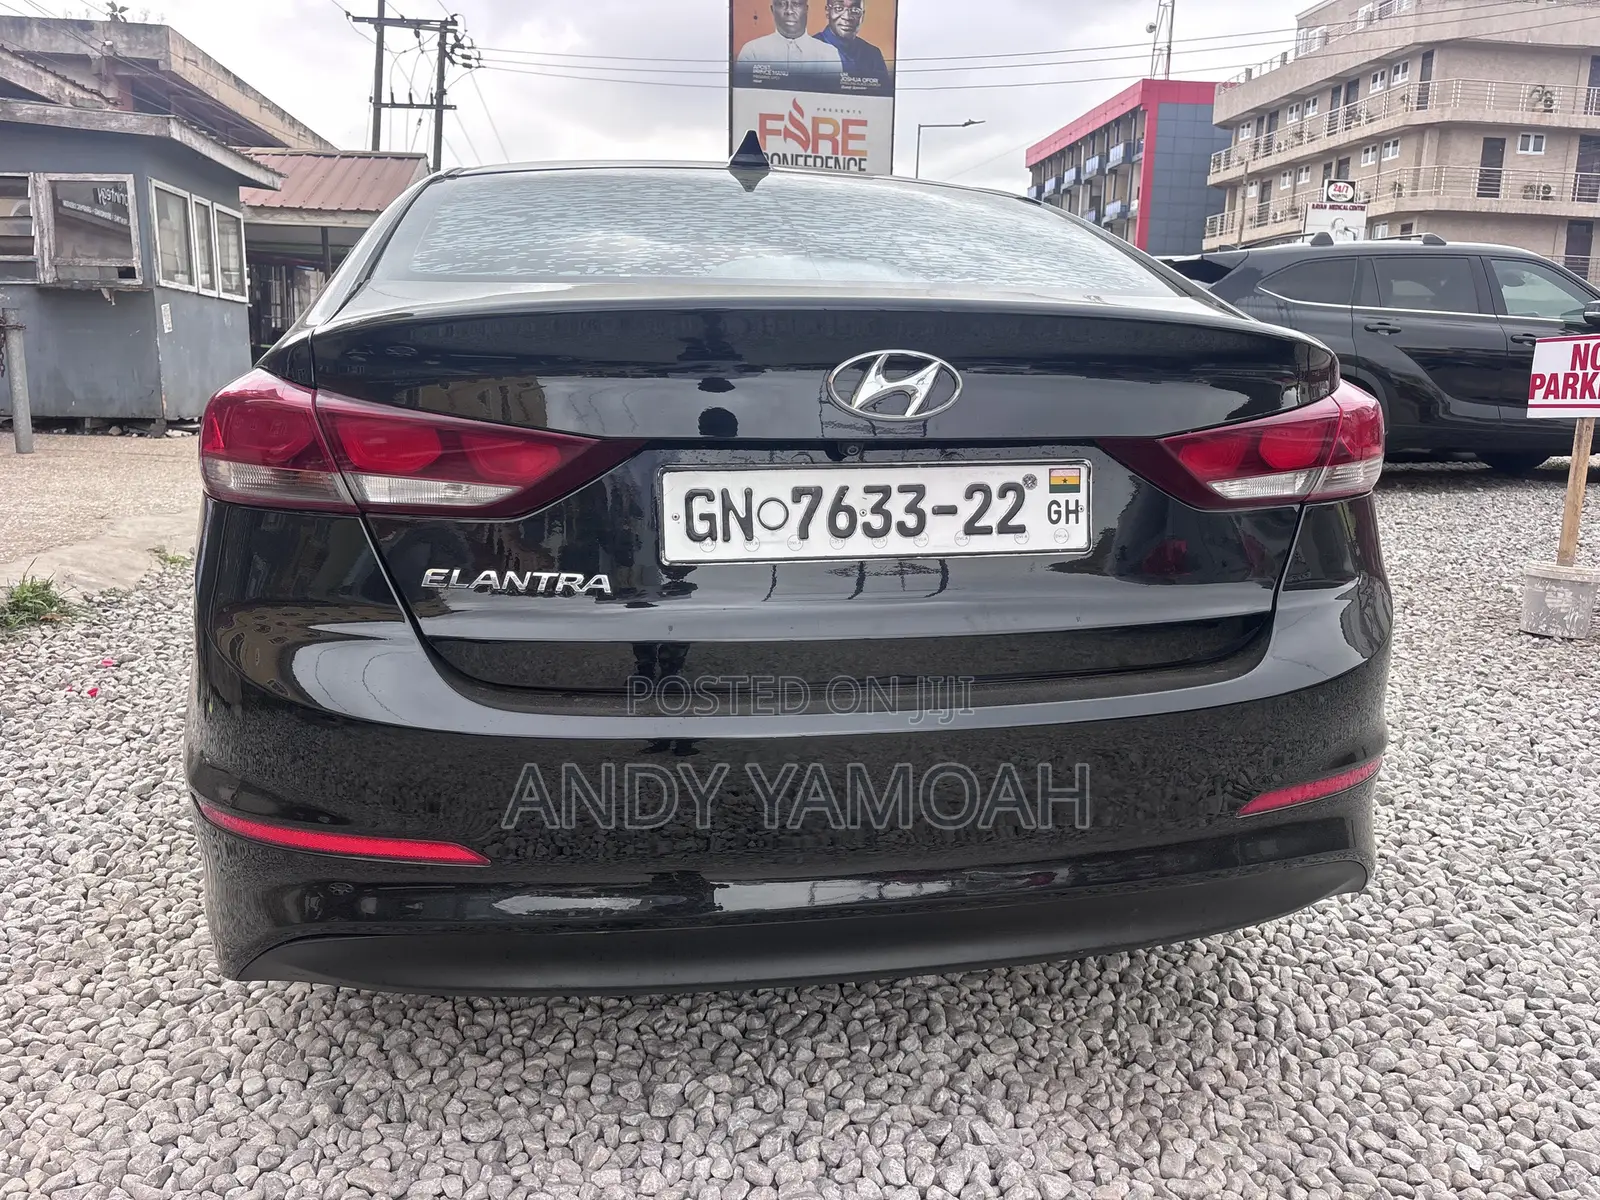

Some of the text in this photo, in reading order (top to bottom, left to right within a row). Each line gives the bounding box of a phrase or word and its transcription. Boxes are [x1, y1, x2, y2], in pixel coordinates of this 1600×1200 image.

[764, 152, 867, 171] ONFERENCE
[1333, 184, 1349, 193] 24/7
[1529, 371, 1600, 400] PARK
[684, 481, 1026, 542] GN 7633-22
[1047, 499, 1080, 525] GH
[421, 568, 612, 593] ELANTRA
